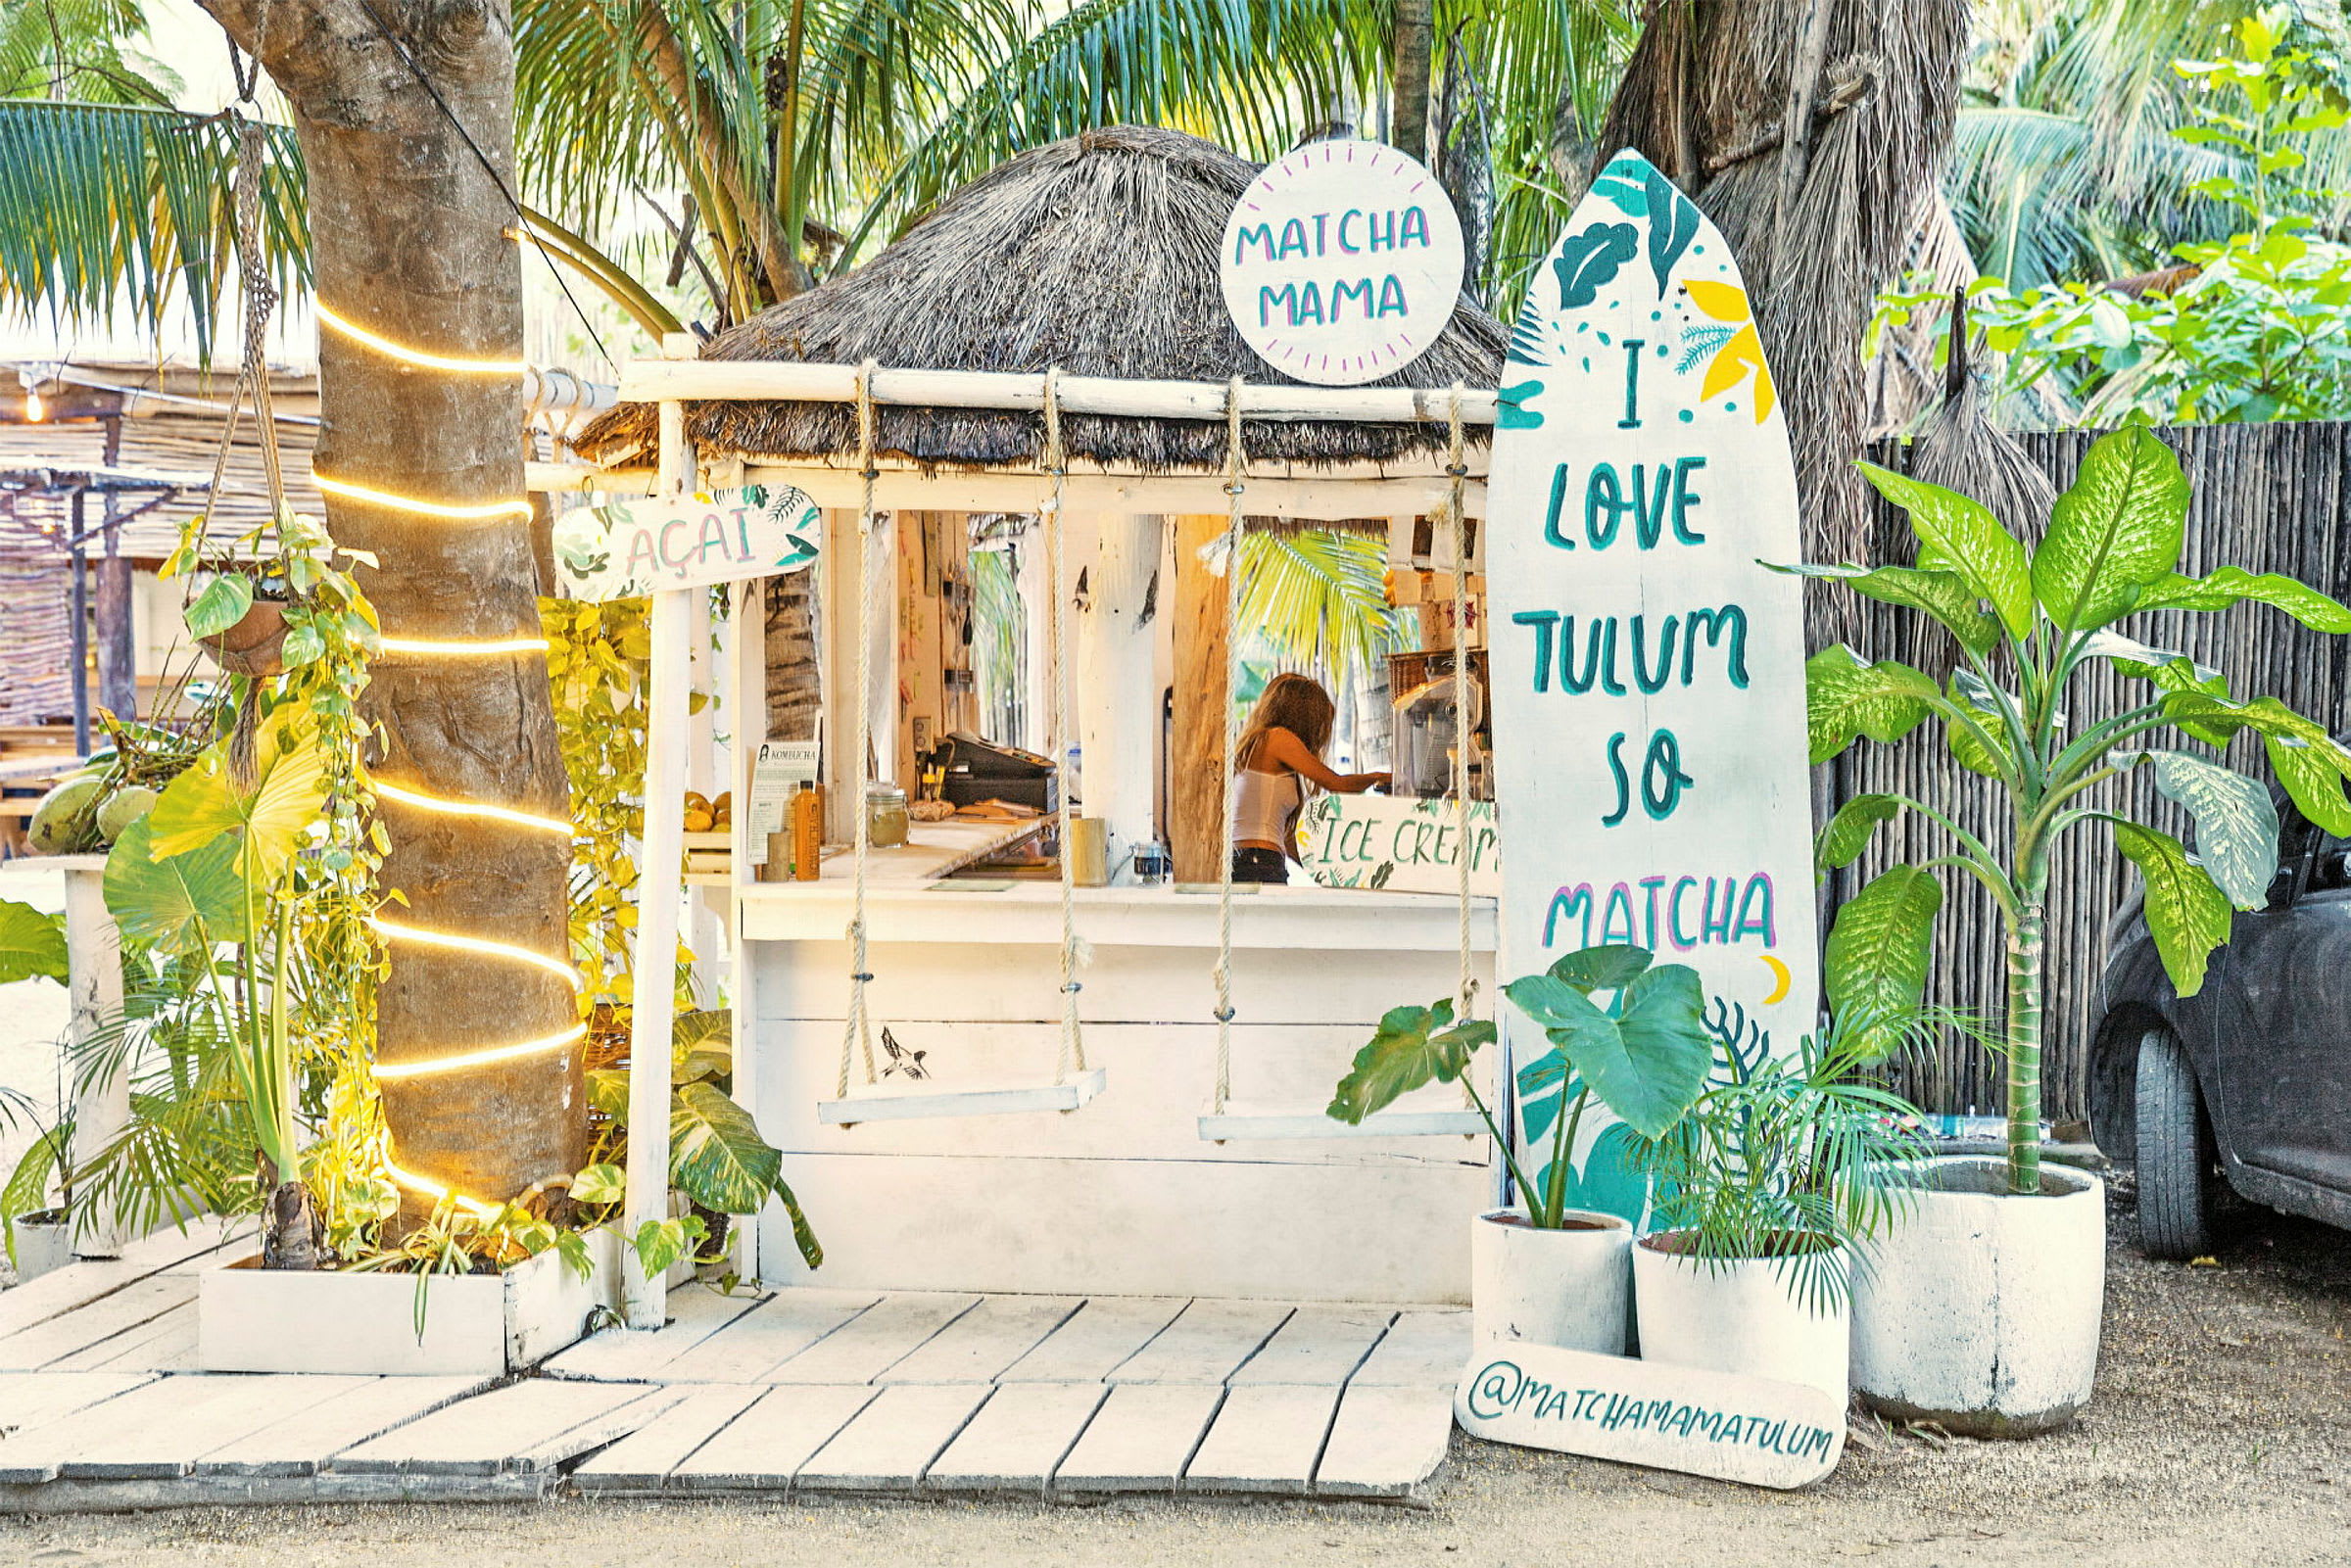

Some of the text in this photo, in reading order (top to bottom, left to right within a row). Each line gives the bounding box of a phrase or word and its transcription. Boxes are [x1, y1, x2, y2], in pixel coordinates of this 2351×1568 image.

[1235, 206, 1431, 265] MATCHA
[1259, 274, 1409, 327] MAMA
[1617, 339, 1646, 429] I
[1544, 456, 1706, 550] LOVE
[1511, 604, 1750, 696] TULUM
[1601, 728, 1695, 829] SO
[1318, 817, 1382, 864] ICE
[1542, 872, 1777, 952] MATCHA
[1467, 1360, 1835, 1465] @MATCHAMAMATULUM
